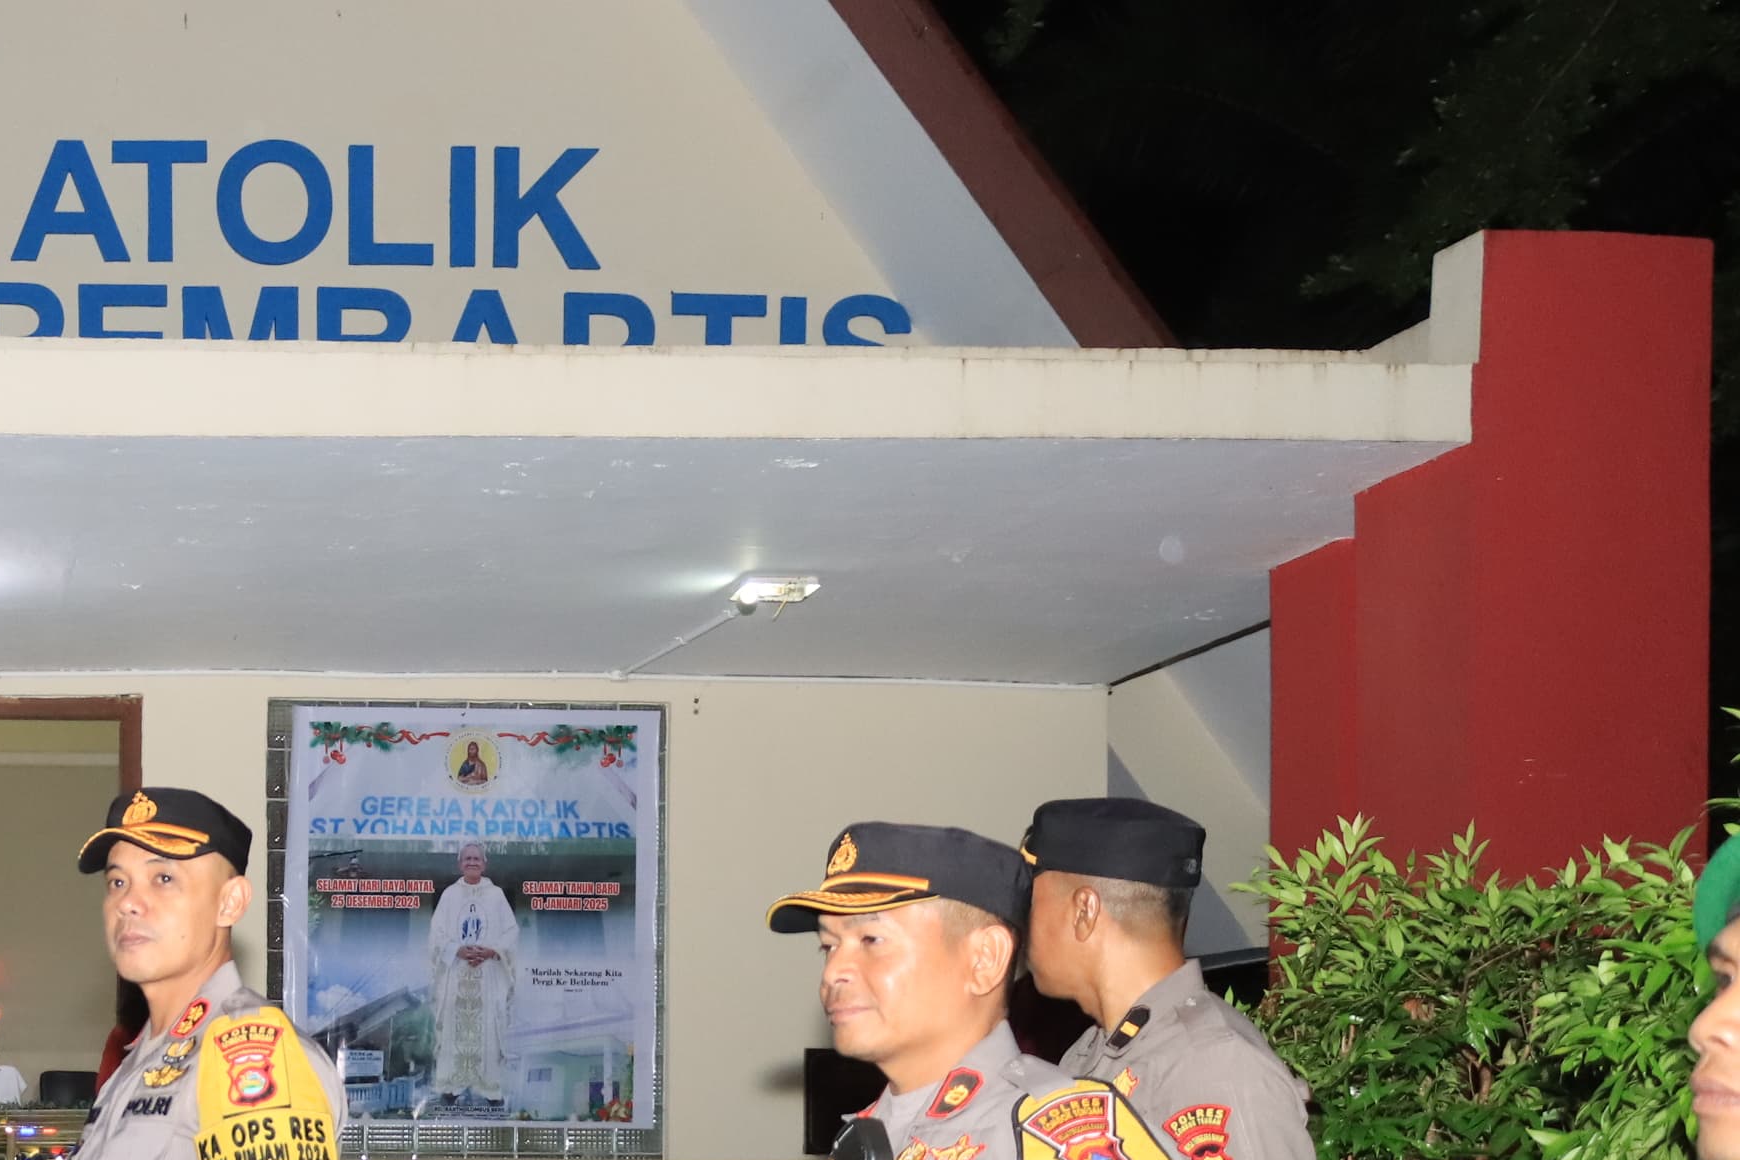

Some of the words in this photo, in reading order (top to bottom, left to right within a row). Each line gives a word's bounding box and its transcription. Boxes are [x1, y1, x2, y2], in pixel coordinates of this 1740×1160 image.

[361, 796, 464, 817] GEREJA
[471, 798, 580, 819] KATOLIK
[316, 879, 358, 893] SELAMAT
[359, 879, 381, 893] HARI
[382, 879, 405, 893] RAYA
[406, 880, 435, 893] NATAL
[523, 881, 564, 895] SELAMAT
[565, 882, 594, 895] TAHUN
[595, 882, 620, 895] BARU
[331, 895, 345, 908] 25
[346, 895, 393, 908] DESEMBER
[394, 895, 420, 909] 2024
[531, 897, 544, 910] 01
[544, 897, 582, 910] JANUARI
[582, 898, 608, 911] 2025
[564, 968, 602, 978] Sekarang
[605, 969, 622, 977] Kita
[532, 978, 553, 986] Pergi
[556, 978, 567, 986] Ke
[121, 1096, 172, 1119] POLRI
[1038, 1097, 1101, 1125] POLRES
[1169, 1107, 1224, 1131] POLRES
[231, 1117, 276, 1148] OPS
[289, 1116, 325, 1143] RES
